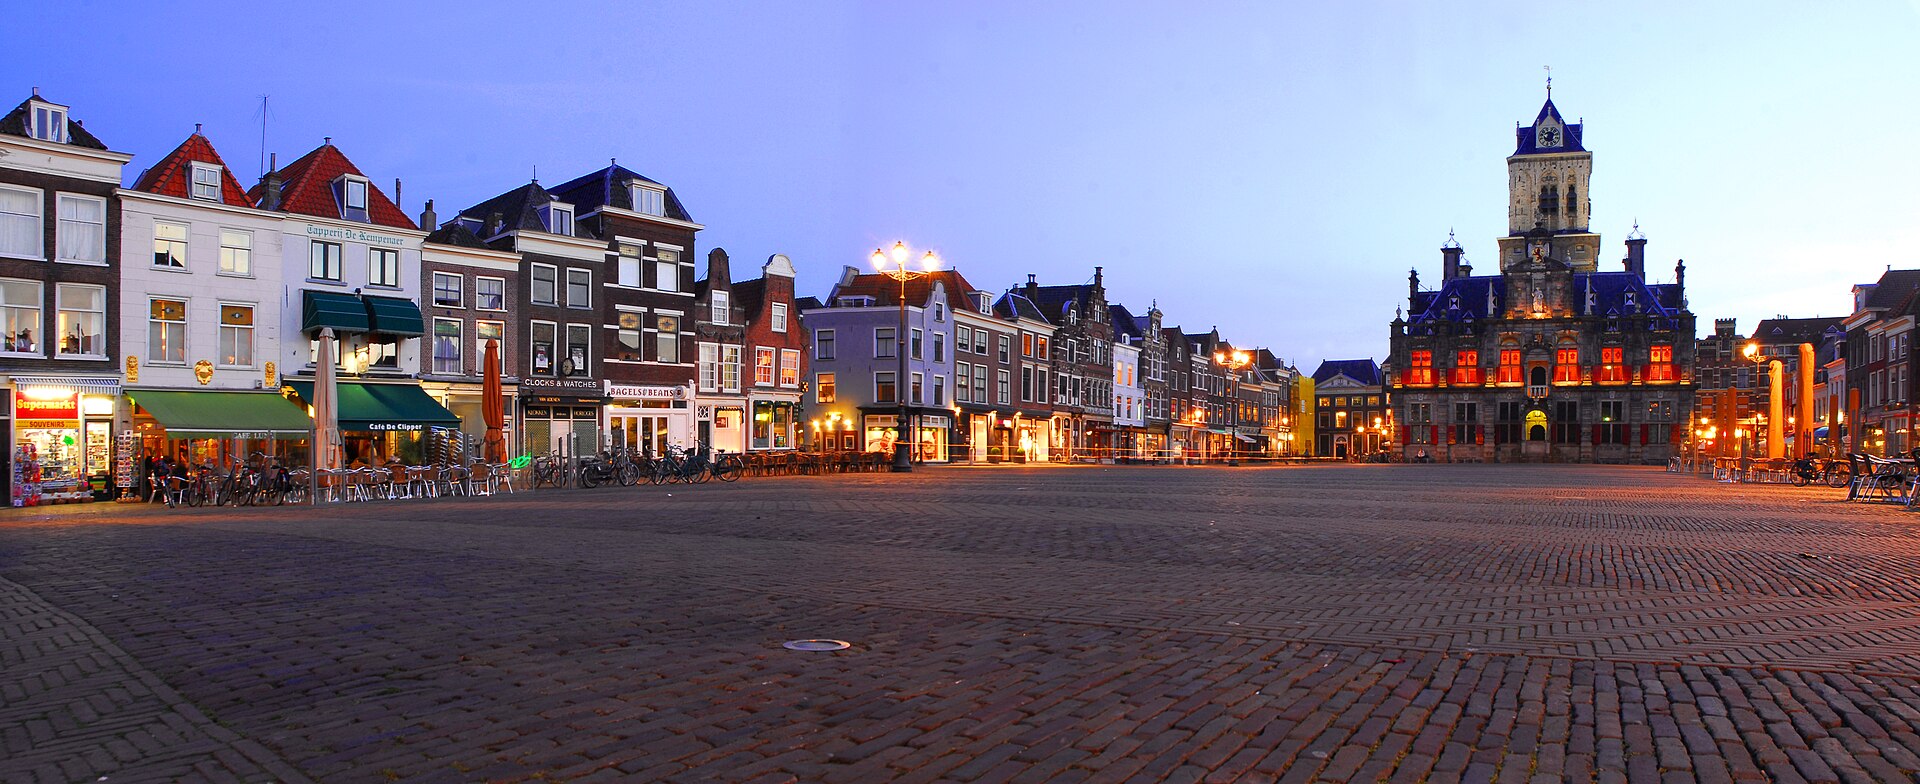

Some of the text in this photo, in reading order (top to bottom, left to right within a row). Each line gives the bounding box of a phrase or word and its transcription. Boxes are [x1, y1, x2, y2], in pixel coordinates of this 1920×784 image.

[307, 224, 404, 245] Tapperij De Kempenaer
[524, 378, 555, 387] CLOCKS
[563, 380, 597, 388] WATCHES
[610, 387, 642, 396] BAGELS
[648, 389, 674, 397] BEANS
[16, 399, 76, 411] Supermarkt
[397, 423, 423, 431] Clipper
